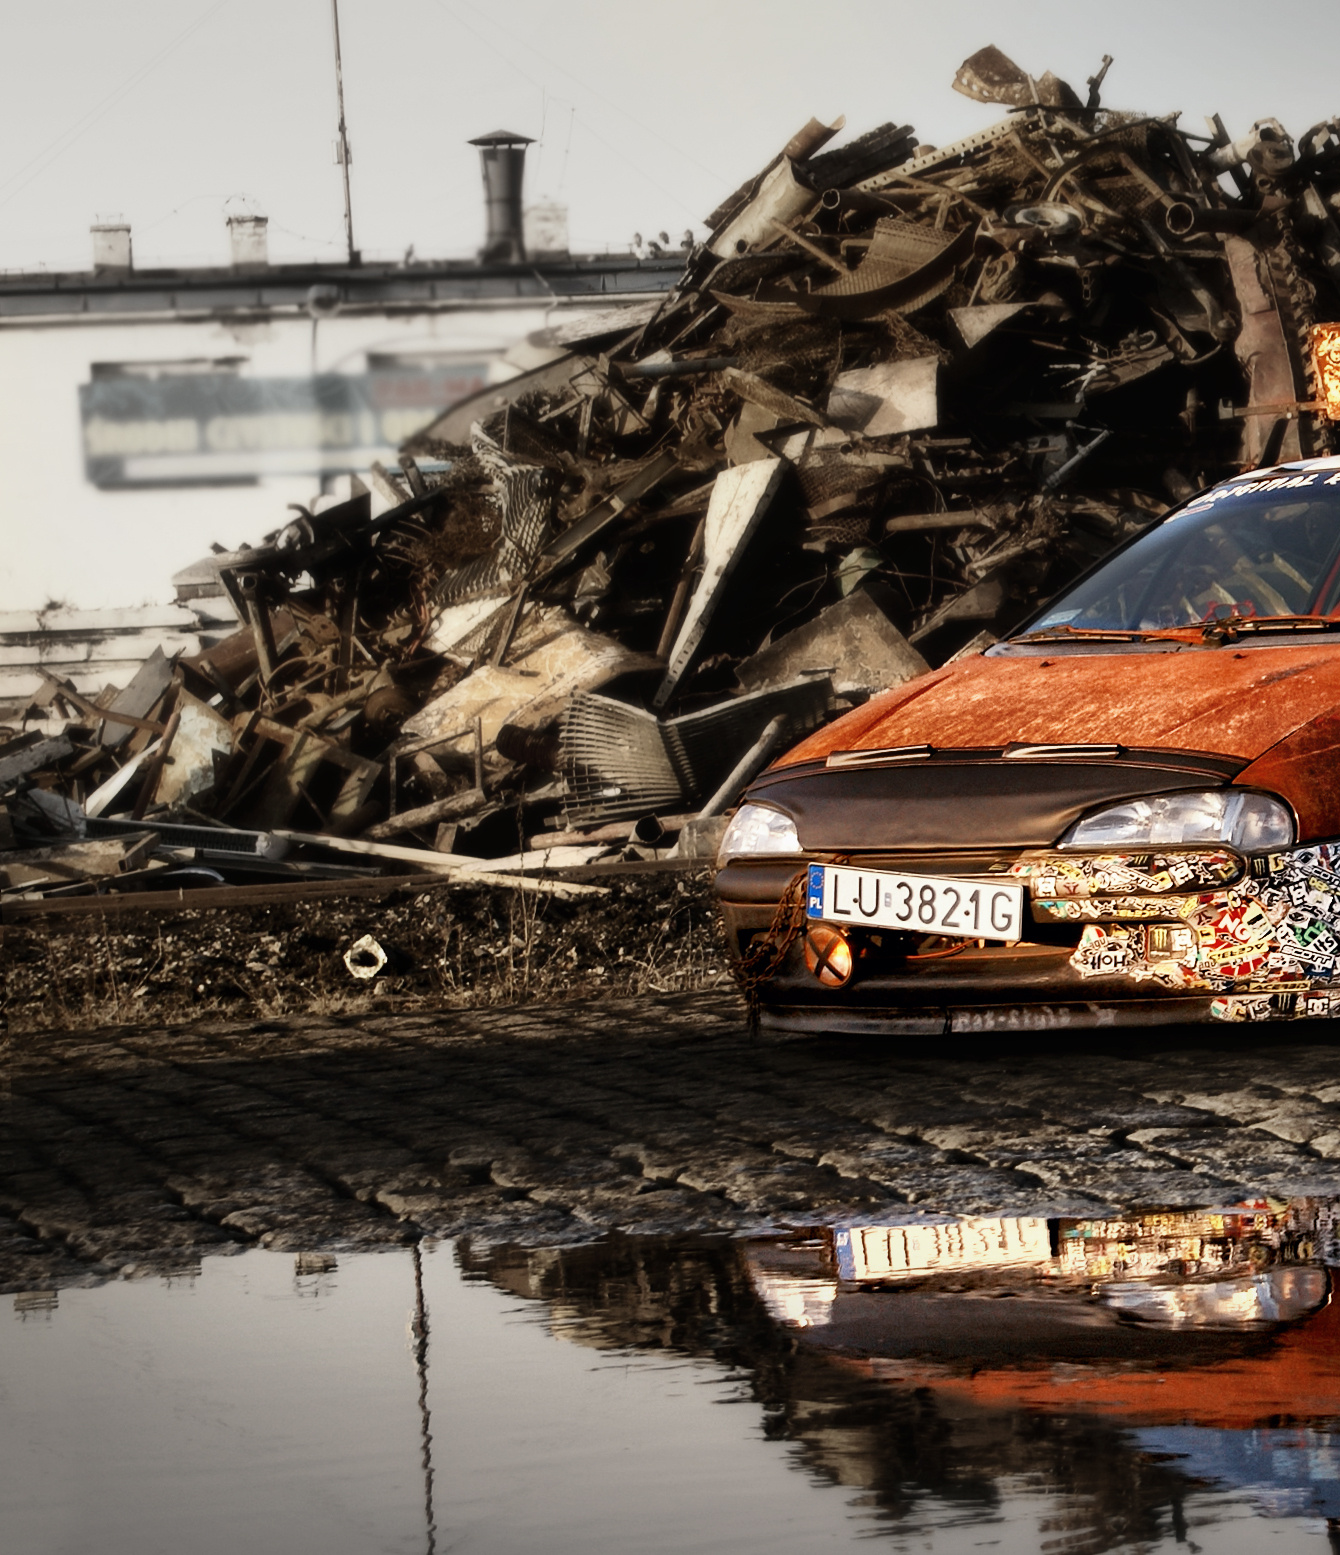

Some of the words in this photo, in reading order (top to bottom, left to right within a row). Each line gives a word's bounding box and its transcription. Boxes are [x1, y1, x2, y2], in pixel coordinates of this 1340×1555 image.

[1187, 473, 1319, 508] ORIGINAL
[809, 896, 823, 910] PL
[833, 874, 880, 918] LU
[896, 882, 1013, 932] 3821G
